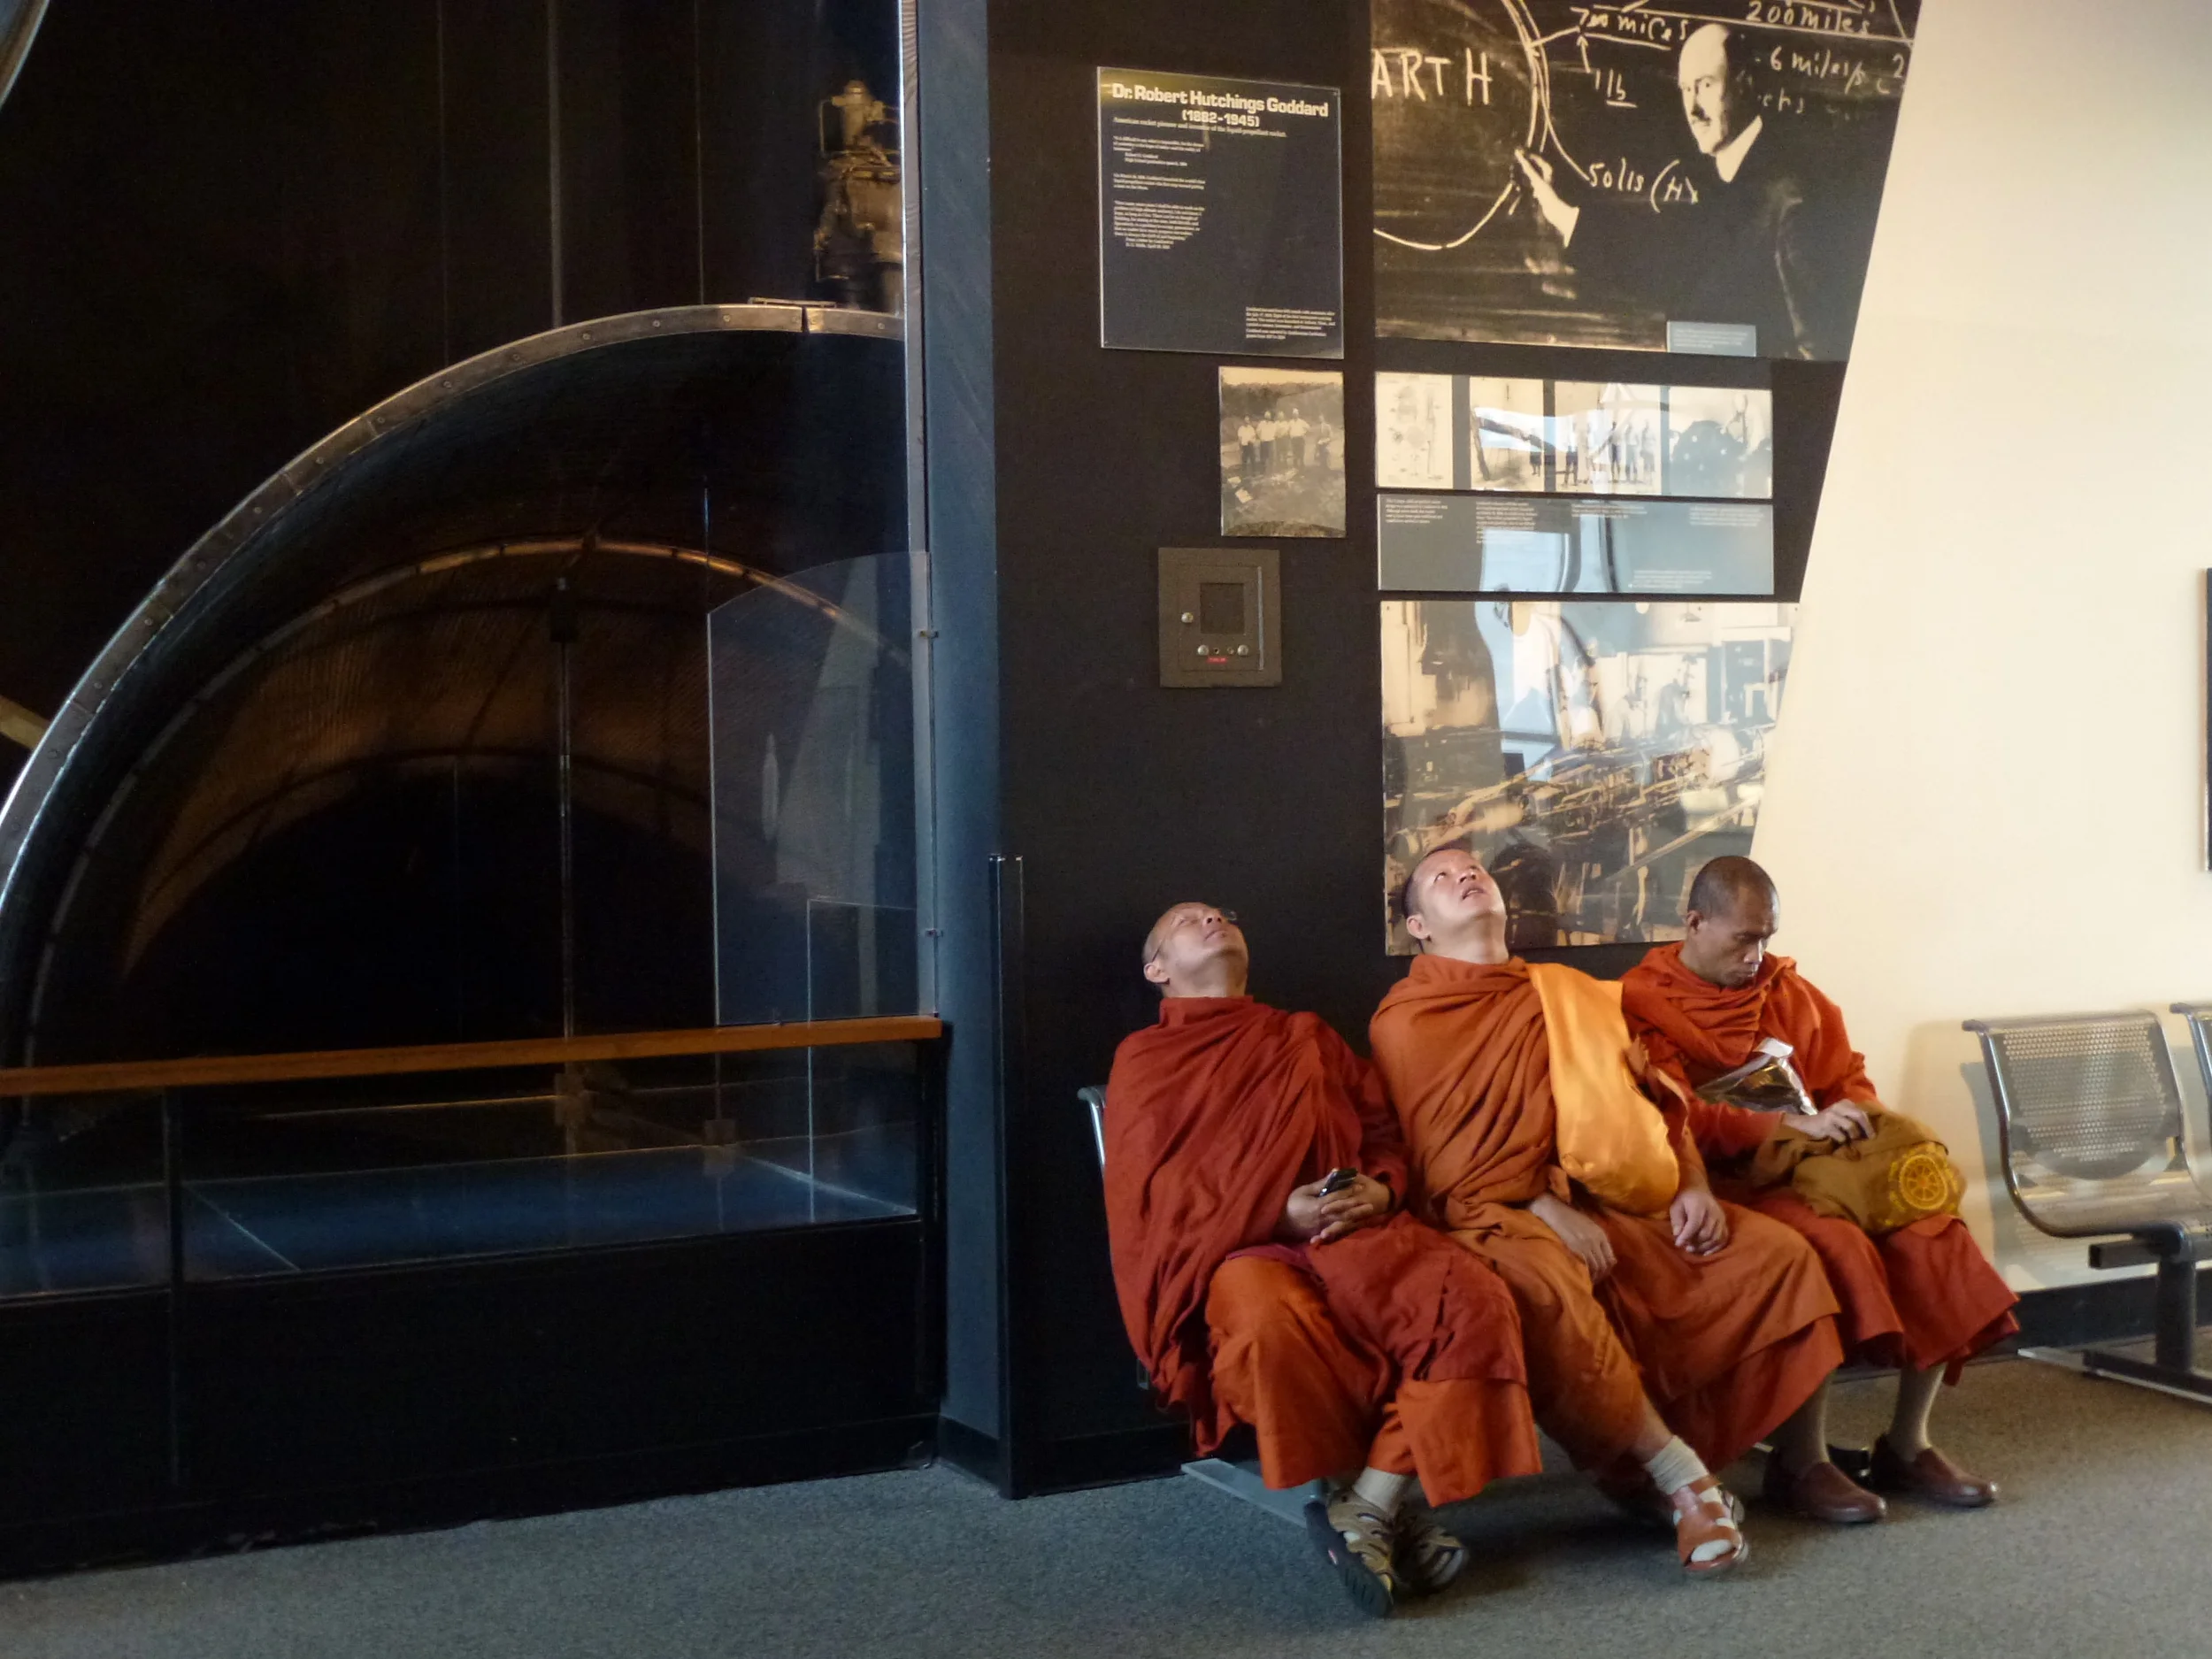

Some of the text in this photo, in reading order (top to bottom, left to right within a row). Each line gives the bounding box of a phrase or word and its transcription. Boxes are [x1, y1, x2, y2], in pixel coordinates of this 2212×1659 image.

[1801, 7, 1870, 35] miles
[1112, 83, 1329, 118] Dr. Robert Hutchings Goddard
[1181, 109, 1260, 128] (1882-1945)
